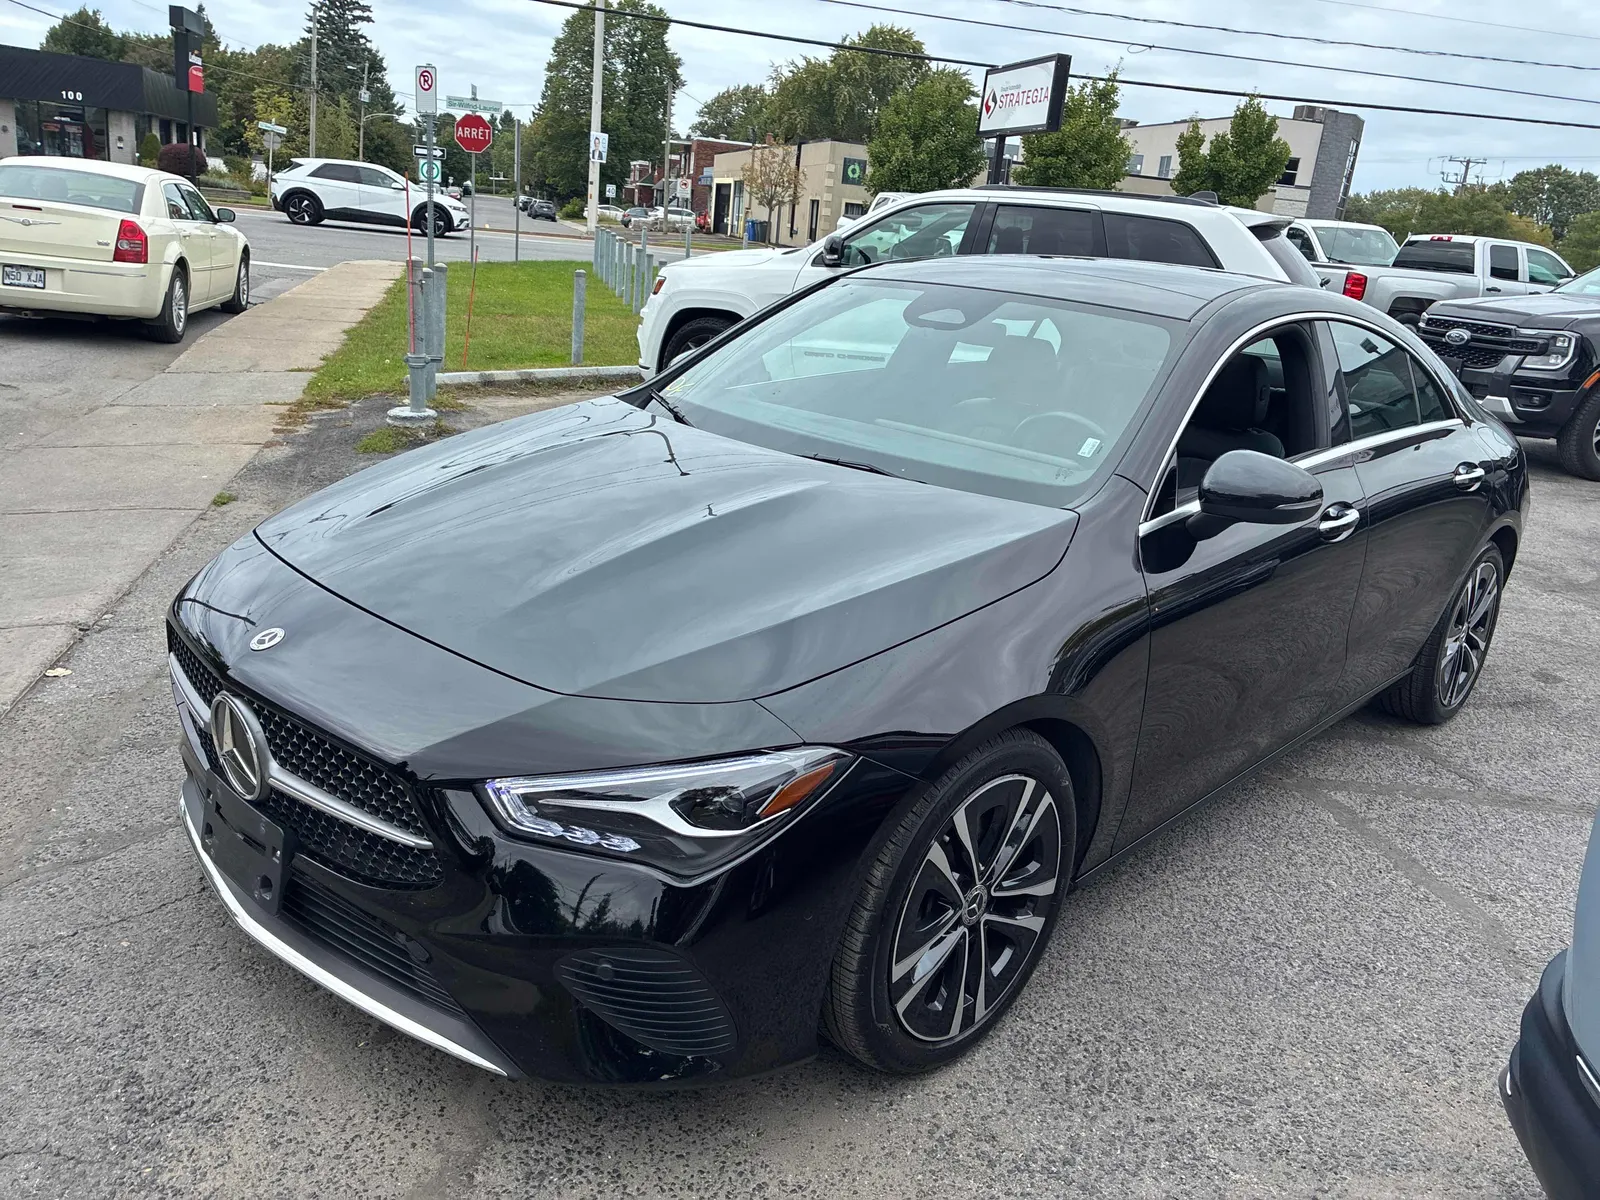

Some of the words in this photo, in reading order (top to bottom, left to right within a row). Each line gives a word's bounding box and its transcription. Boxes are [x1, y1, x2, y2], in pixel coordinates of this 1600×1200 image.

[61, 90, 83, 101] 100
[998, 86, 1049, 109] STRATEGIA
[457, 126, 490, 140] ARRÊT
[27, 272, 44, 283] XJA
